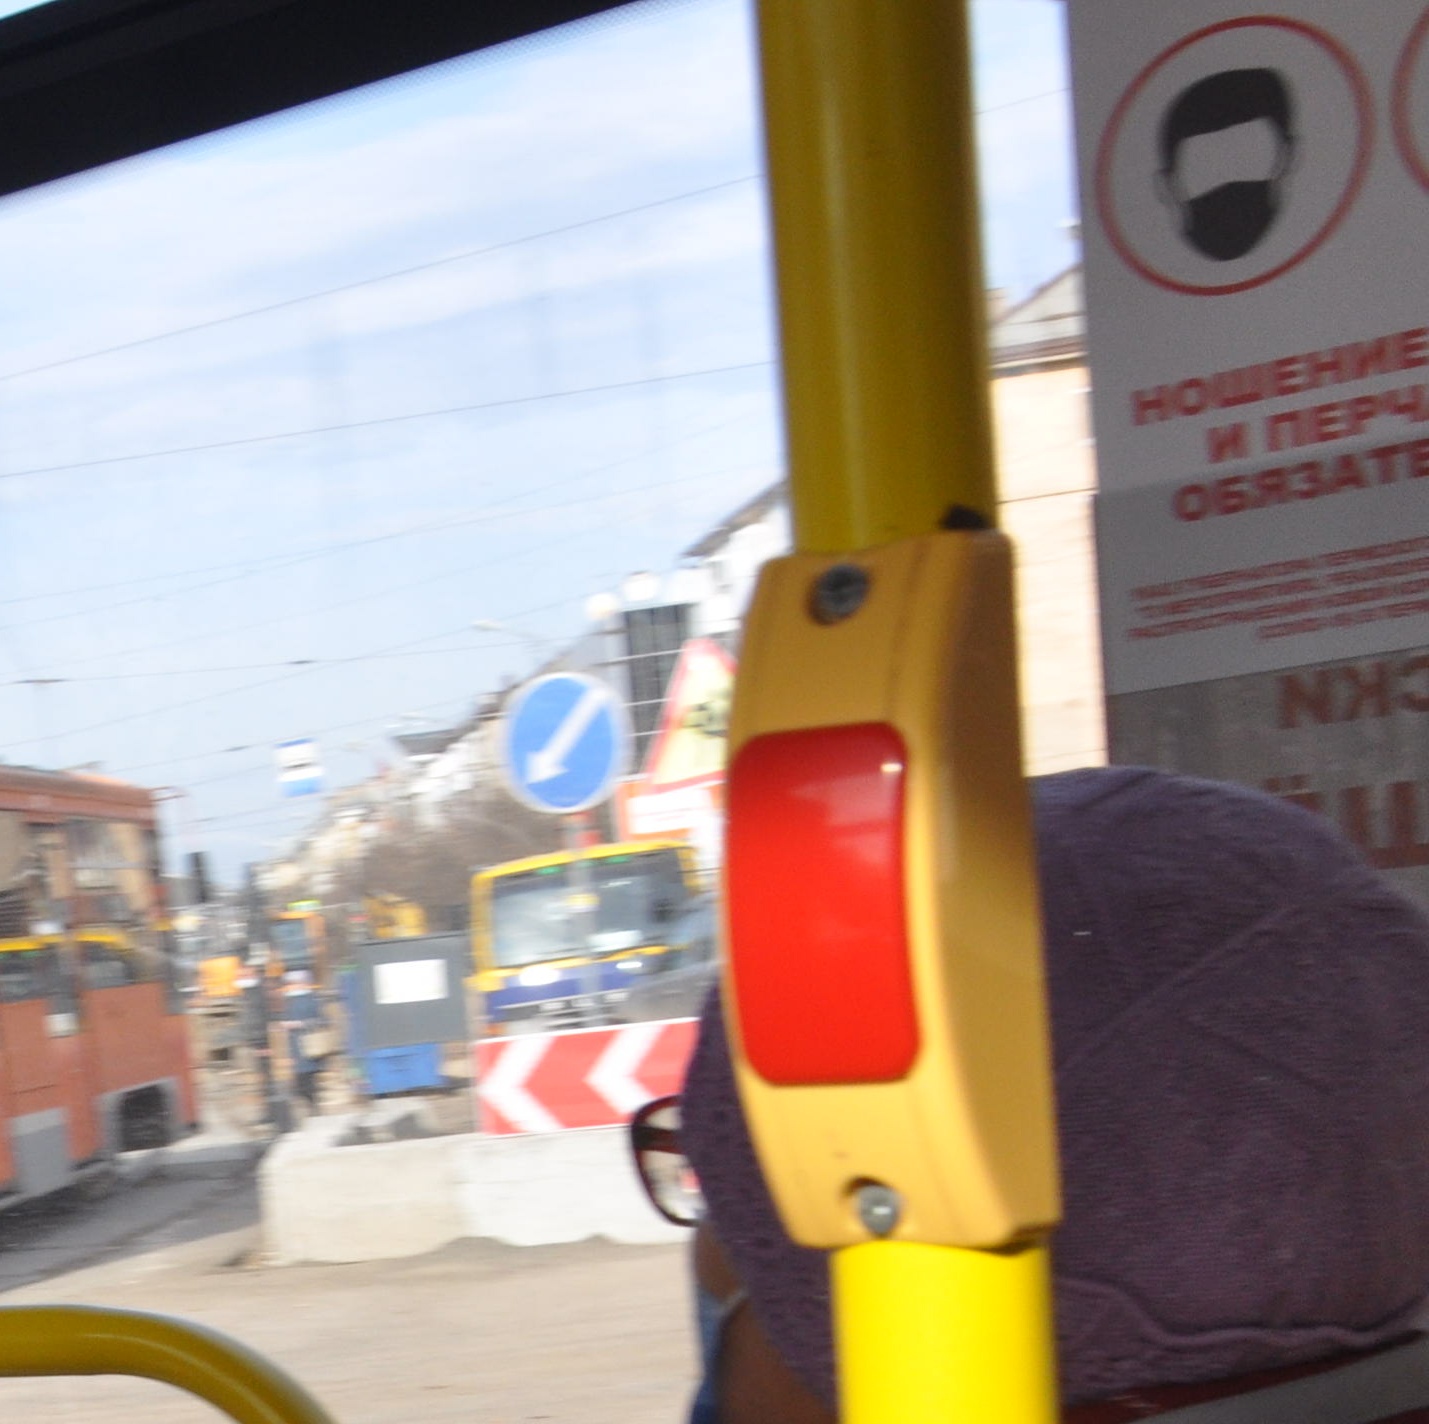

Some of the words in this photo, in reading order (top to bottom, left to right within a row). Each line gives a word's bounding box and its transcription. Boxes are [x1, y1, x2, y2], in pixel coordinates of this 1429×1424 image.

[1131, 326, 1428, 427] НОШЕНИЕ
[1205, 421, 1249, 465] И
[1264, 382, 1428, 453] ПЕРЧ
